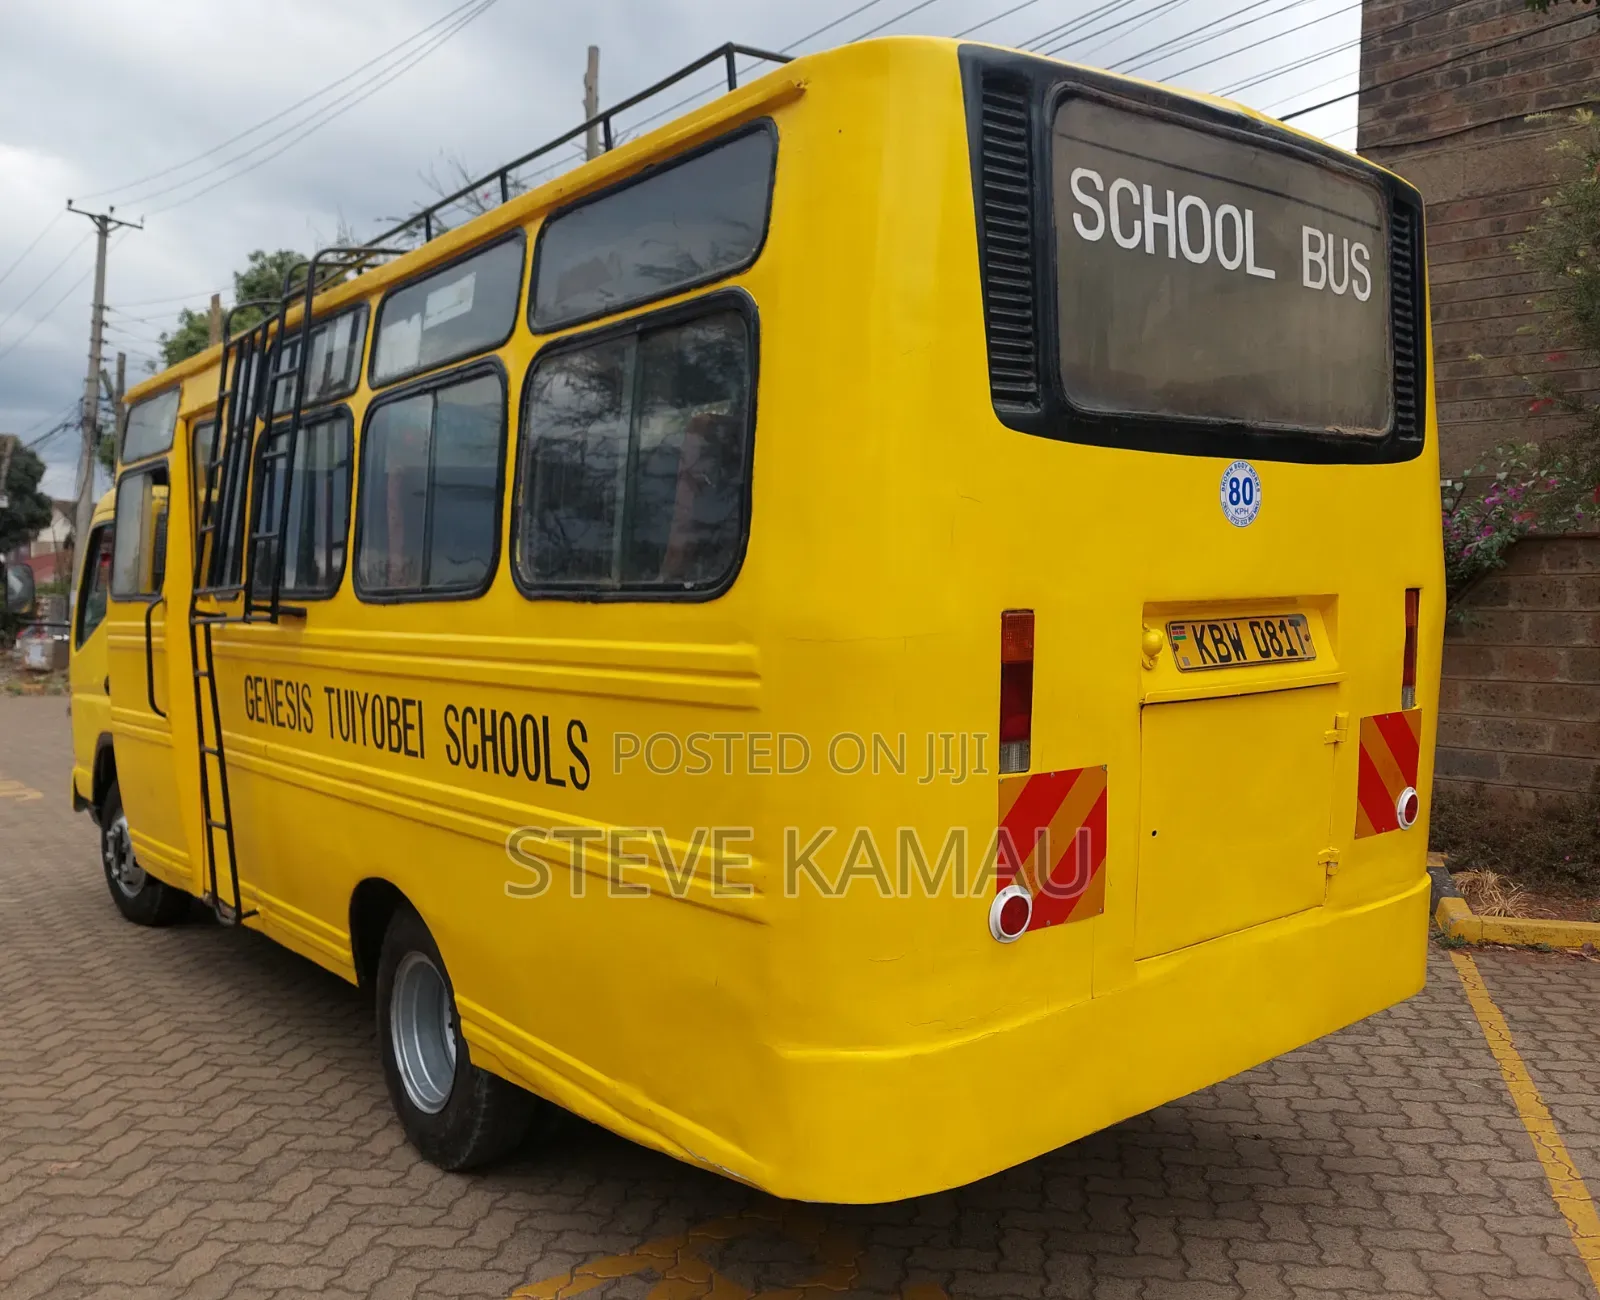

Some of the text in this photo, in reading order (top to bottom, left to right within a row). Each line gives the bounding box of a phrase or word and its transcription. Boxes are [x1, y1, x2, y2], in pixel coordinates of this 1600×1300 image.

[1070, 167, 1372, 302] SCHOOL BUS
[1228, 476, 1254, 506] 80
[1234, 507, 1249, 515] KPH
[1191, 622, 1248, 664] KBW
[244, 675, 591, 792] GENESIS TUIYOBEI SCHOOLS
